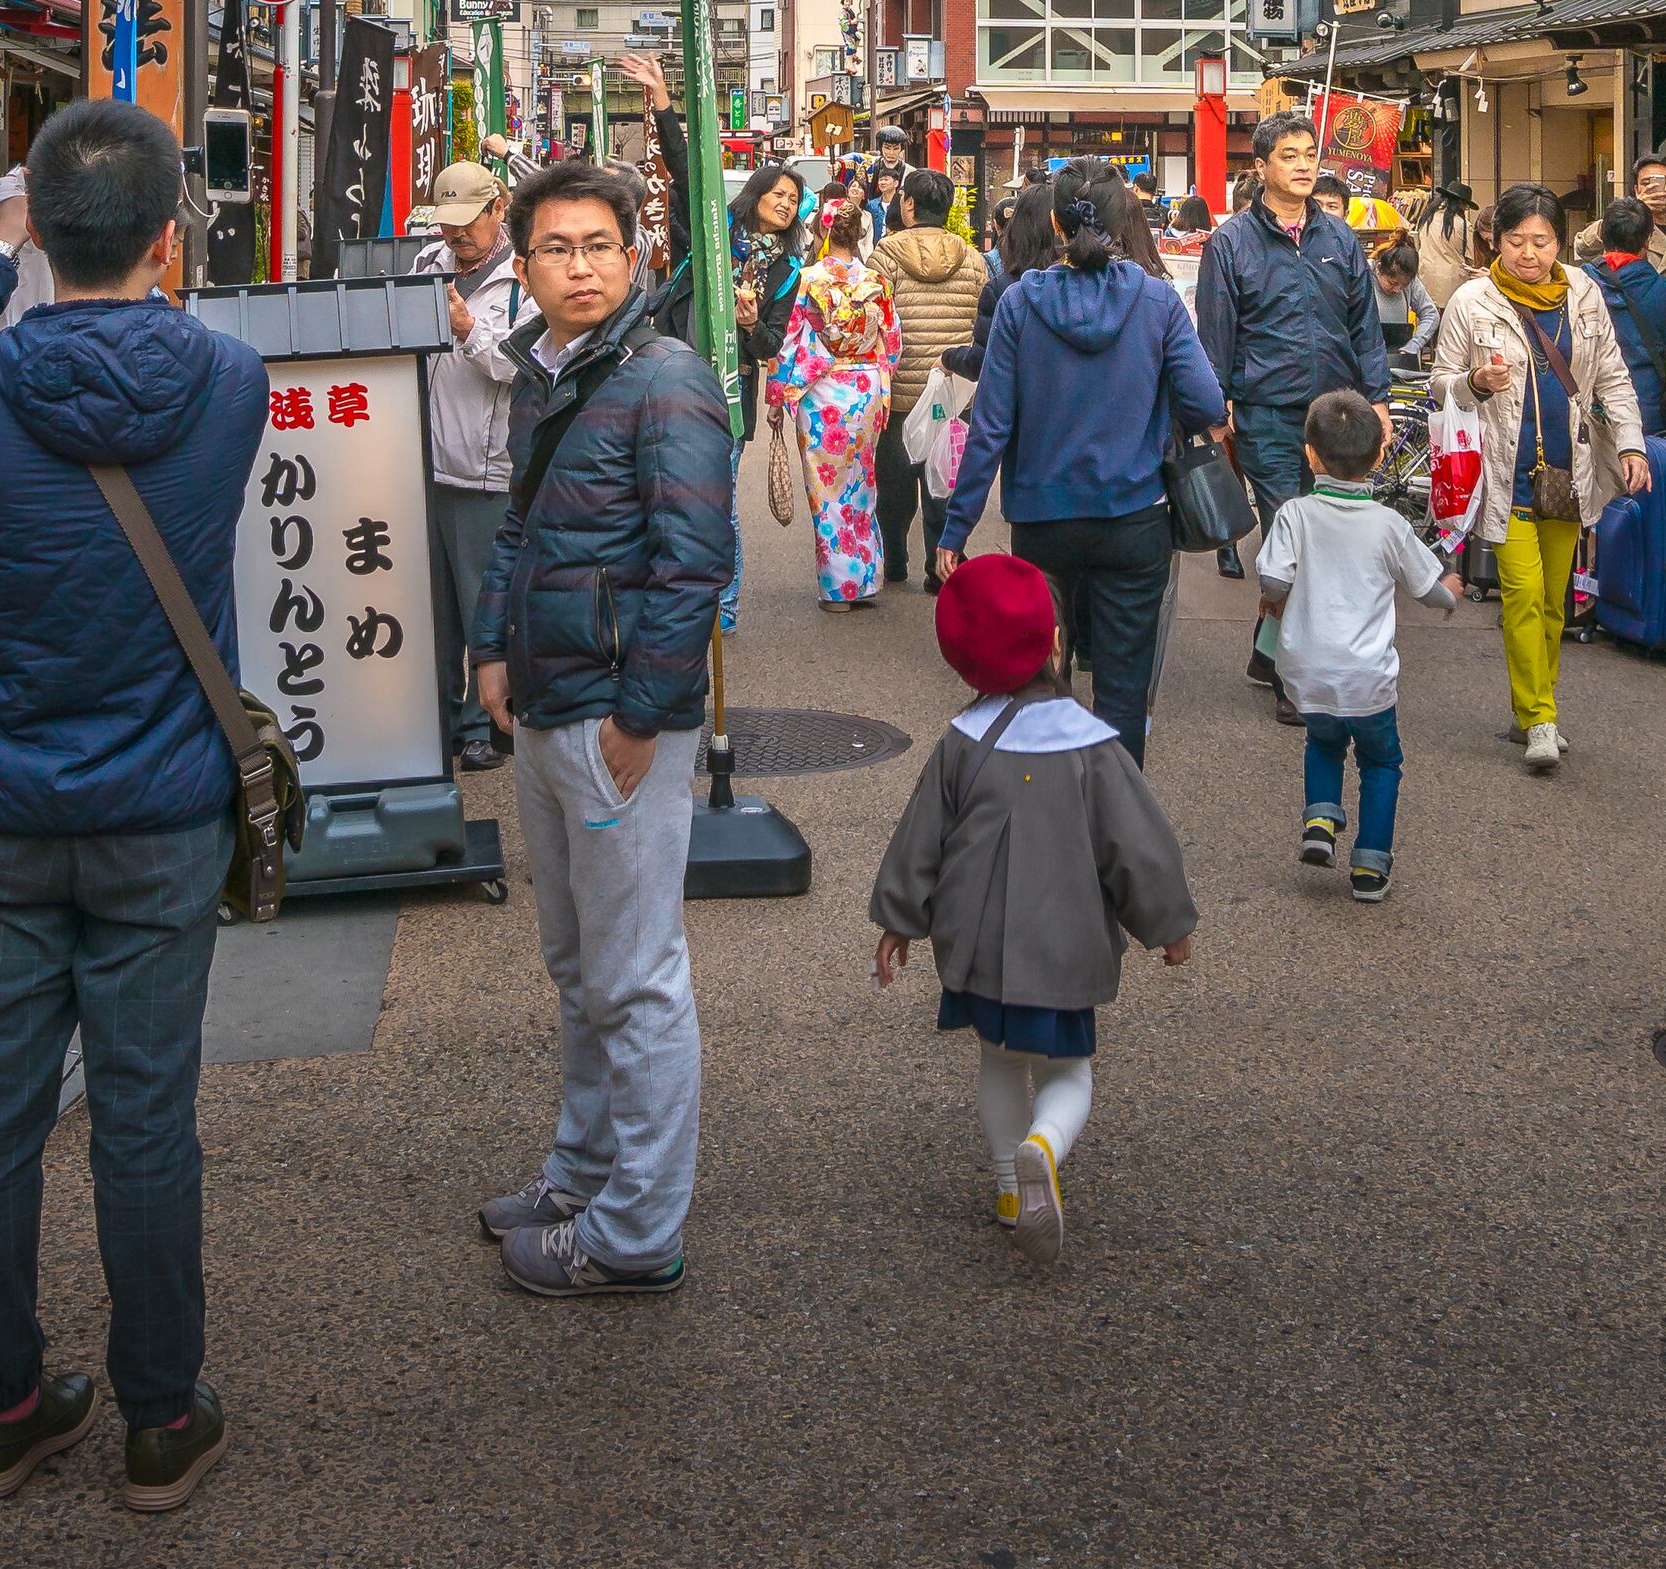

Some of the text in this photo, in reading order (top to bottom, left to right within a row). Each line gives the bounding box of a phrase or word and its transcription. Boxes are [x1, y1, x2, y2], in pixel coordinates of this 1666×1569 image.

[459, 0, 489, 10] Bunny
[1327, 147, 1373, 163] YUMENOYA
[269, 383, 371, 431] 浅草
[260, 451, 326, 764] かりんとう
[343, 516, 404, 660] まめ
